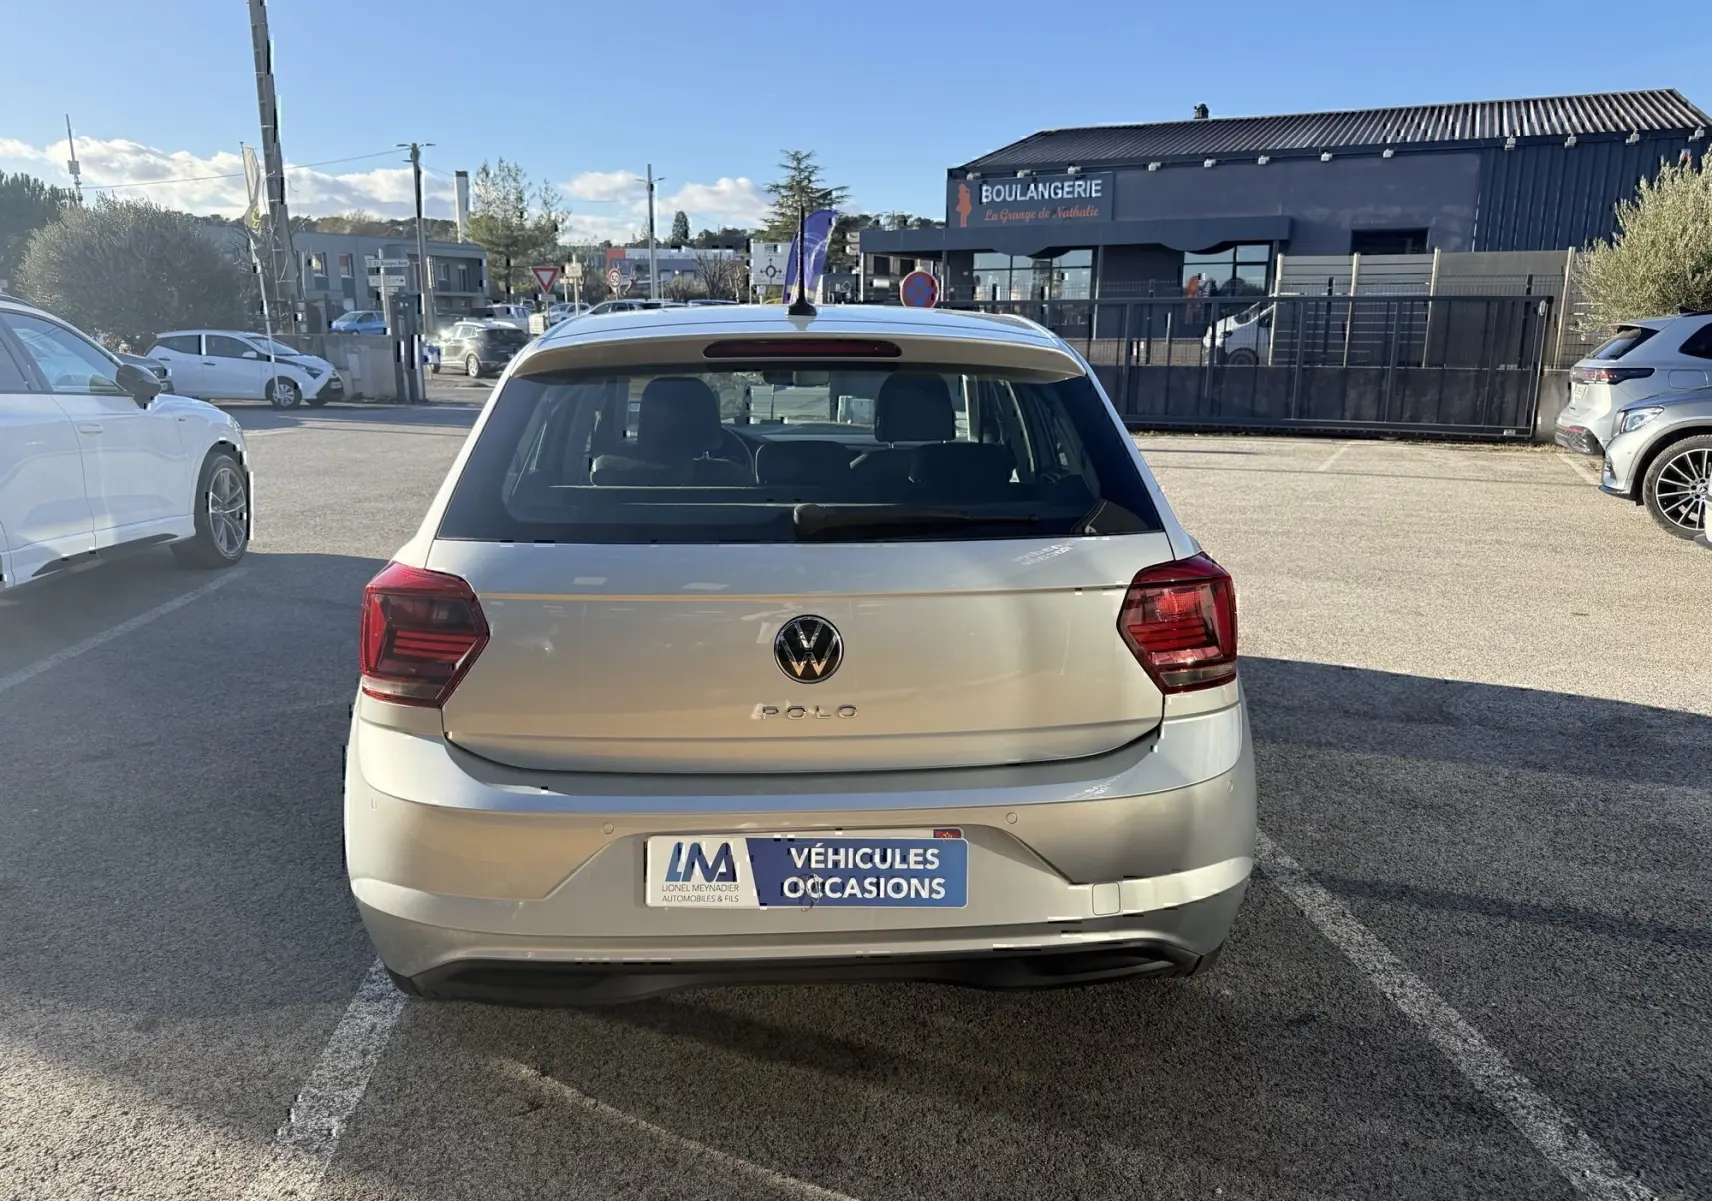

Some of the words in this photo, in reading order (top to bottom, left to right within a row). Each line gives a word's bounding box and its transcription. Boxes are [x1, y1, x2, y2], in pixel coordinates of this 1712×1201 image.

[981, 180, 1102, 203] BOULANGERIE
[984, 209, 999, 221] La
[1001, 208, 1036, 223] Grange
[1038, 207, 1051, 218] de
[1052, 205, 1099, 219] Nathalie
[762, 704, 858, 720] POLO
[790, 842, 940, 870] VÉHICULES
[661, 884, 690, 892] LIONEL
[692, 884, 739, 892] MEYNADIER
[783, 876, 946, 900] OCCASIONS
[661, 894, 716, 903] AUTOMOBILES
[717, 894, 723, 902] &
[724, 894, 739, 902] FILS
